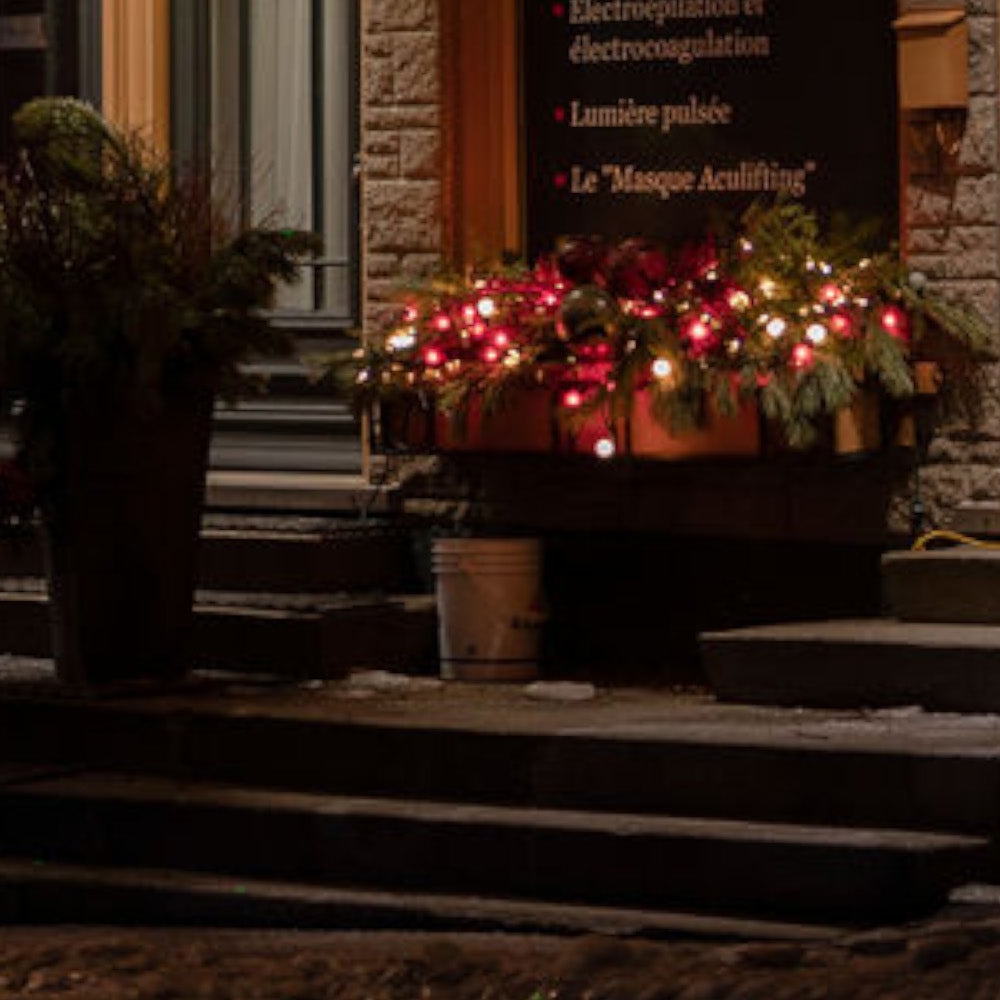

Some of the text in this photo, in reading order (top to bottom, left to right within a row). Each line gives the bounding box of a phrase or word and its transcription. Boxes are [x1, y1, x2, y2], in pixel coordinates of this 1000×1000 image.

[569, 27, 769, 64] électrocoagulation
[570, 94, 733, 133] Lumière pulsée
[570, 164, 599, 194] Le
